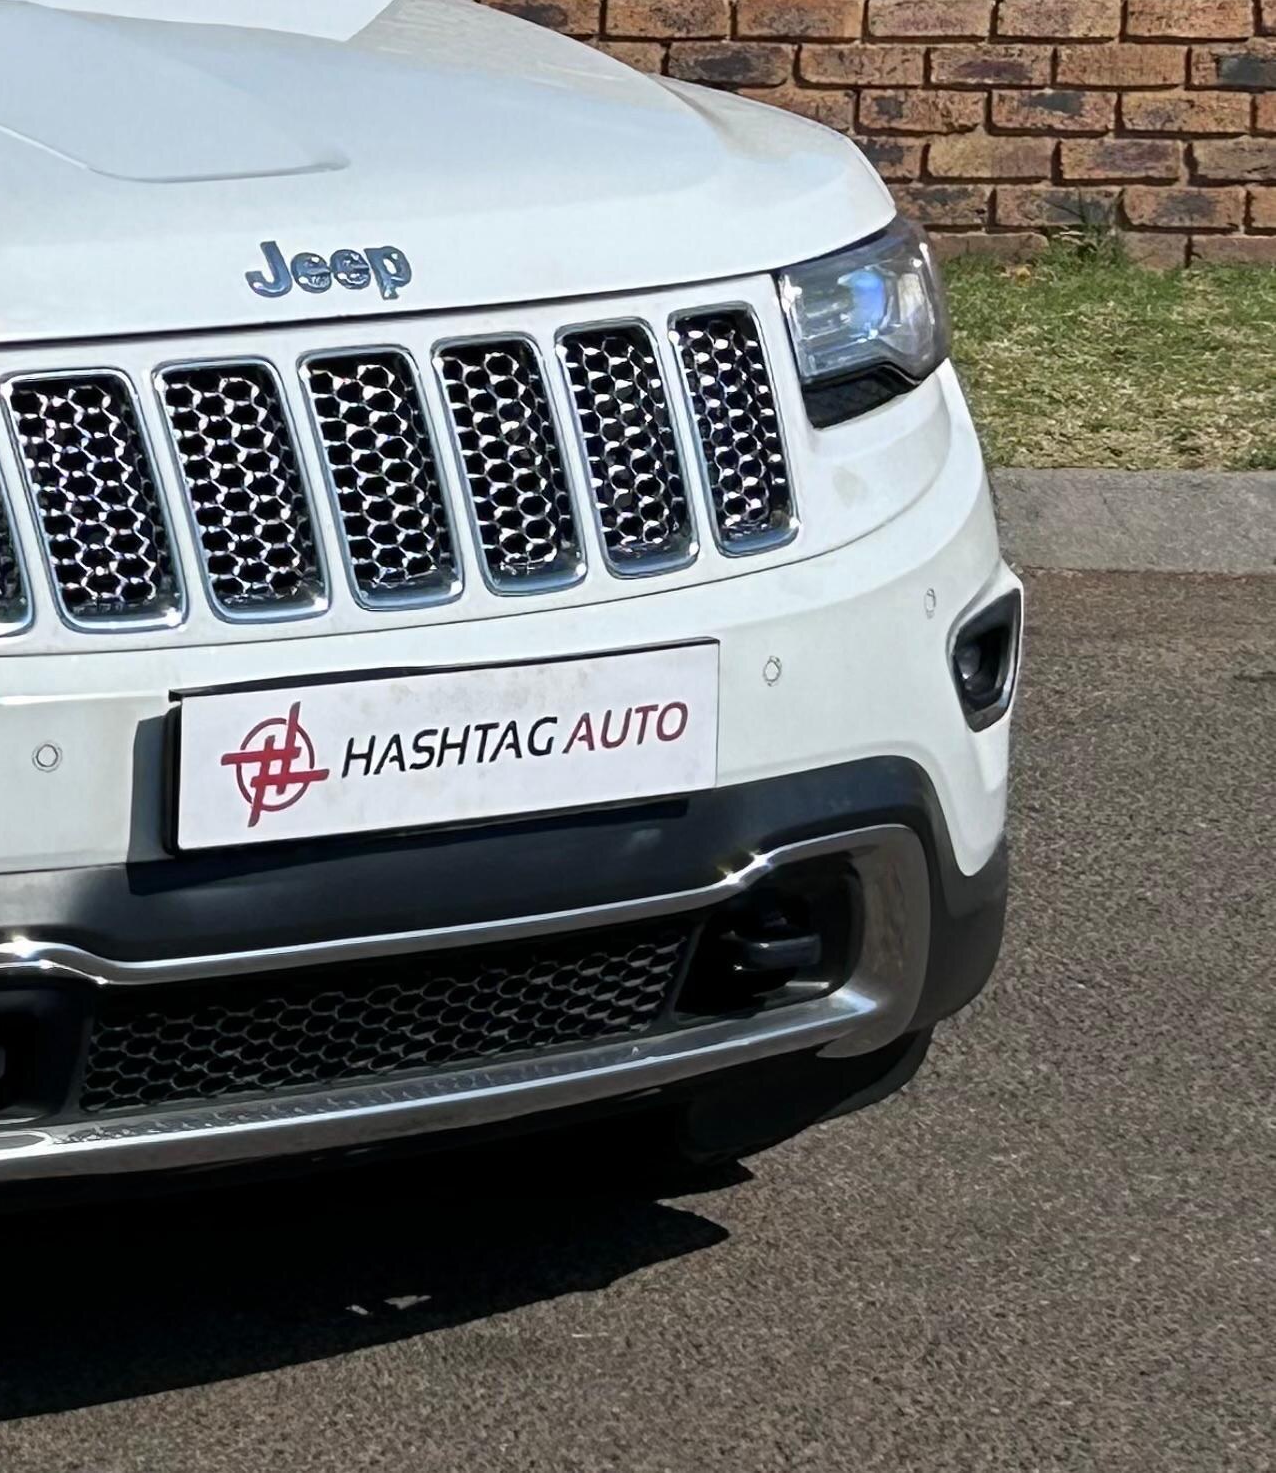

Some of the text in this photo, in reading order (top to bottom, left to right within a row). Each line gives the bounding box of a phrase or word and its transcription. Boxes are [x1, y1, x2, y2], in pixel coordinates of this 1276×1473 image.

[244, 240, 413, 301] Jeep
[341, 701, 689, 779] HASHTAG AUTO
